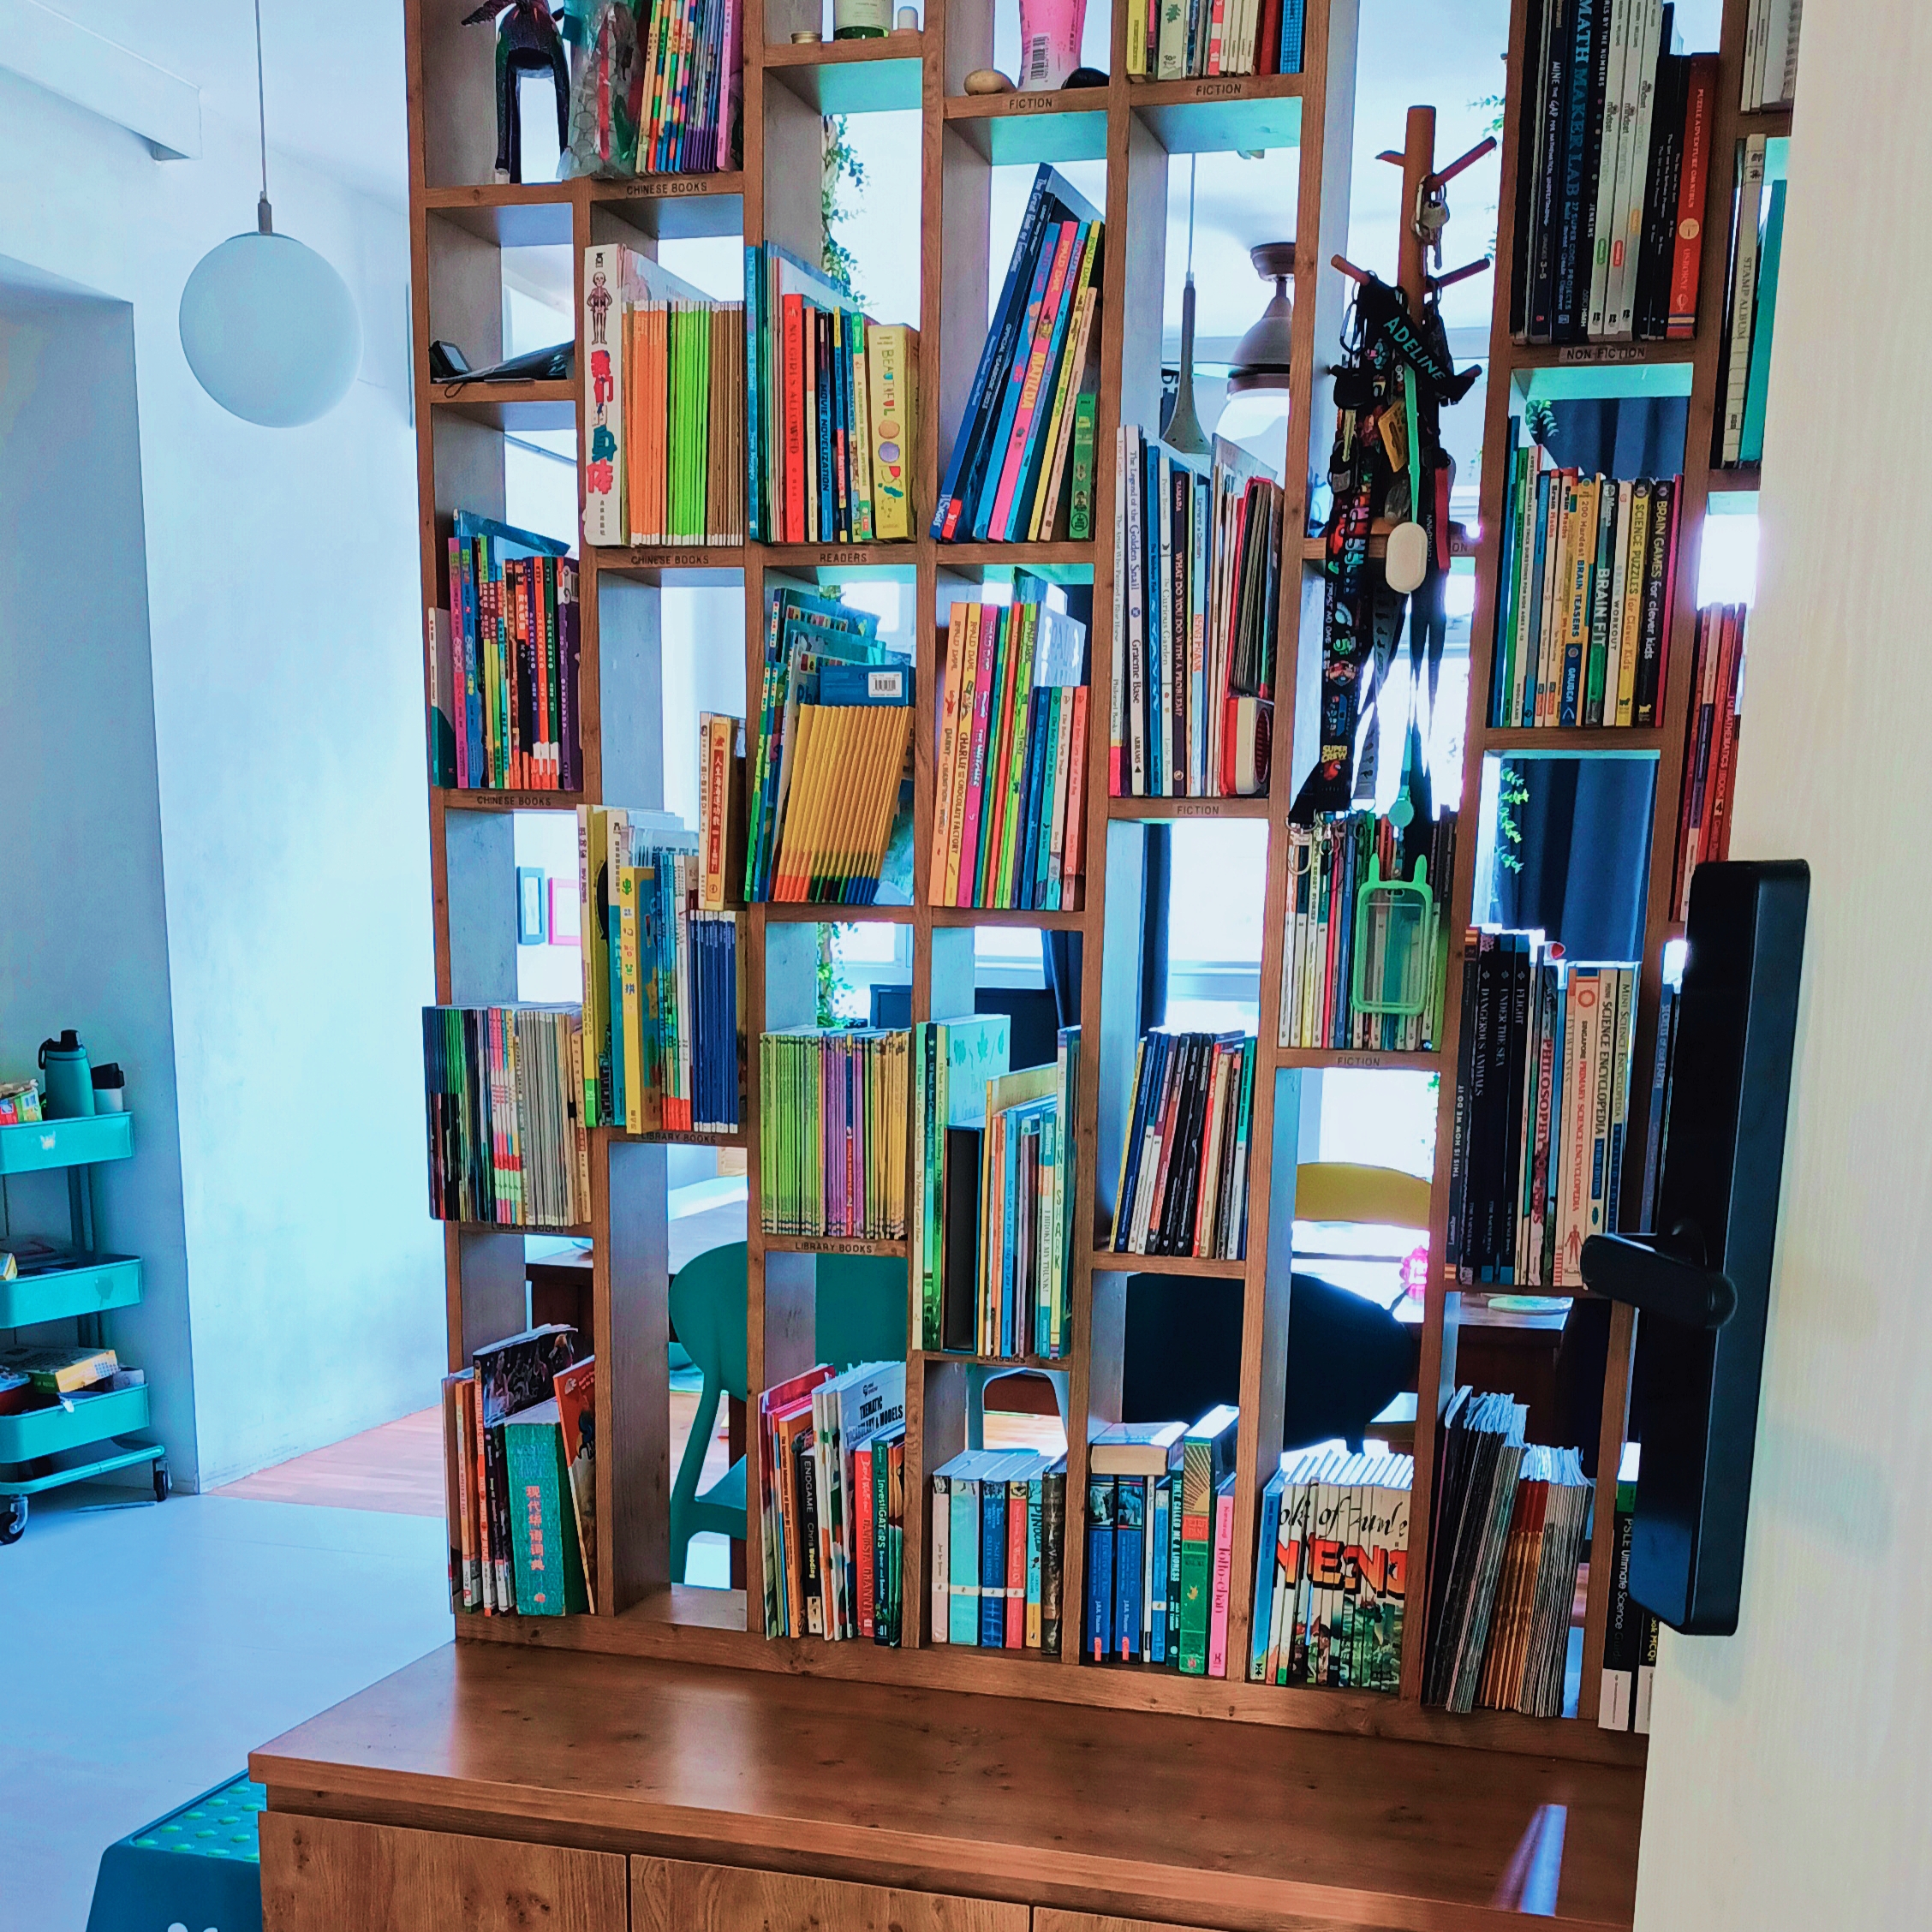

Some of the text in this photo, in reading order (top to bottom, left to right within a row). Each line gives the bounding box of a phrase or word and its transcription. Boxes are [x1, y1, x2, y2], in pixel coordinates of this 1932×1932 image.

[1602, 17, 1609, 27] BY
[1551, 61, 1562, 85] MINE
[1598, 48, 1607, 86] NUMBERS
[1009, 98, 1052, 110] FICTION
[1196, 83, 1242, 96] FICTION
[1550, 99, 1560, 116] GAP
[1566, 0, 1593, 197] MATH MAKER LAB
[1606, 101, 1619, 133] mindset
[1623, 103, 1636, 134] mindset
[627, 182, 707, 196] CHINESE BOOKS
[1029, 192, 1043, 212] Great
[1035, 178, 1046, 190] The
[1024, 214, 1036, 231] Book
[1587, 203, 1595, 237] JENKINS
[1051, 239, 1070, 292] ROALD DAHL
[1079, 236, 1096, 290] ROALD DAHL
[1565, 213, 1579, 310] SUPER COOL PROJECTS
[1679, 248, 1690, 290] USBORNE
[1737, 257, 1752, 339] STAMP ALBUM
[987, 324, 1011, 391] OFFICIAL YEARBOOK
[1382, 316, 1446, 381] ADELINE
[1566, 347, 1644, 360] NON FICTION
[789, 323, 801, 455] NO GIRLS ALLOWED
[881, 349, 896, 417] BEAUTIFUL
[1021, 352, 1046, 410] MATILDA
[820, 383, 830, 492] MOVIE NOVELIZATION
[1129, 468, 1137, 497] Legend
[631, 555, 709, 565] CHINESE BOOKS
[820, 553, 868, 563] READERS
[1130, 524, 1140, 561] Golden
[1130, 564, 1140, 590] Snail
[1174, 552, 1183, 579] WHAT
[1571, 501, 1589, 637] 200 Hardest BRAIN TEASERS
[1644, 500, 1667, 659] BRAIN GAMES for clever kids
[1175, 581, 1183, 596] DO
[1623, 504, 1645, 670] SCIENCE PUZZLES for Clever Kids
[1162, 589, 1171, 629] Curious
[1174, 598, 1183, 617] YOU
[1174, 618, 1183, 634] DO
[1326, 611, 1333, 623] NO
[1592, 568, 1610, 647] BRAIN FIT
[1610, 565, 1624, 651] BRAIN WORKOUT
[950, 621, 961, 671] ROALD DAHL
[966, 621, 976, 671] ROALD DAHL
[1174, 636, 1183, 660] WITH
[1193, 613, 1203, 672] BEING FRANK
[1132, 639, 1142, 704] Graeme Base
[1174, 671, 1183, 716] PROBLEM?
[1720, 709, 1734, 768] MATHEMATICS
[477, 796, 552, 807] CHINESE BOOKS
[951, 732, 969, 854] CHARLIE CHOCOLATE FACTORY
[1177, 805, 1219, 815] FICTION
[1515, 987, 1525, 1025] FLIGHT
[1660, 1005, 1671, 1036] SECRETS
[1475, 987, 1491, 1096] DANGEROUS ANIMALS
[1495, 987, 1510, 1067] UNDER THE SEA
[1337, 1057, 1380, 1067] FICTION
[1595, 1001, 1613, 1135] SCIENCE ENCYCLOPEDIA
[1614, 983, 1631, 1117] MINI SCIENCE ENCYCLOPEDIA
[1458, 1084, 1464, 1093] IT
[1536, 1038, 1553, 1143] PHILOSOPHY
[1577, 1060, 1588, 1101] PRIMARY
[1655, 1063, 1667, 1088] EARTH
[1455, 1112, 1463, 1124] WE
[1457, 1095, 1464, 1108] DO
[641, 1131, 716, 1143] LIBRARY BOOKS
[1575, 1104, 1585, 1142] SCIENCE
[1572, 1144, 1583, 1212] ENCYCLOPEDIA
[1593, 1142, 1603, 1196] THIRD EDITION
[1533, 1186, 1544, 1225] KIDS
[795, 1242, 873, 1253] LIBRARY BOOKS
[1043, 1247, 1050, 1259] MY
[805, 1461, 814, 1513] ENDGAME
[1173, 1500, 1182, 1528] CALLED
[1622, 1518, 1633, 1547] PSLE
[1172, 1530, 1181, 1541] ME
[862, 1518, 874, 1613] GANGSTA GRANNY
[1172, 1552, 1180, 1582] LIONESS
[1214, 1545, 1231, 1614] Totto-chan
[1615, 1591, 1628, 1630] Science
[1612, 1631, 1624, 1663] Guide
